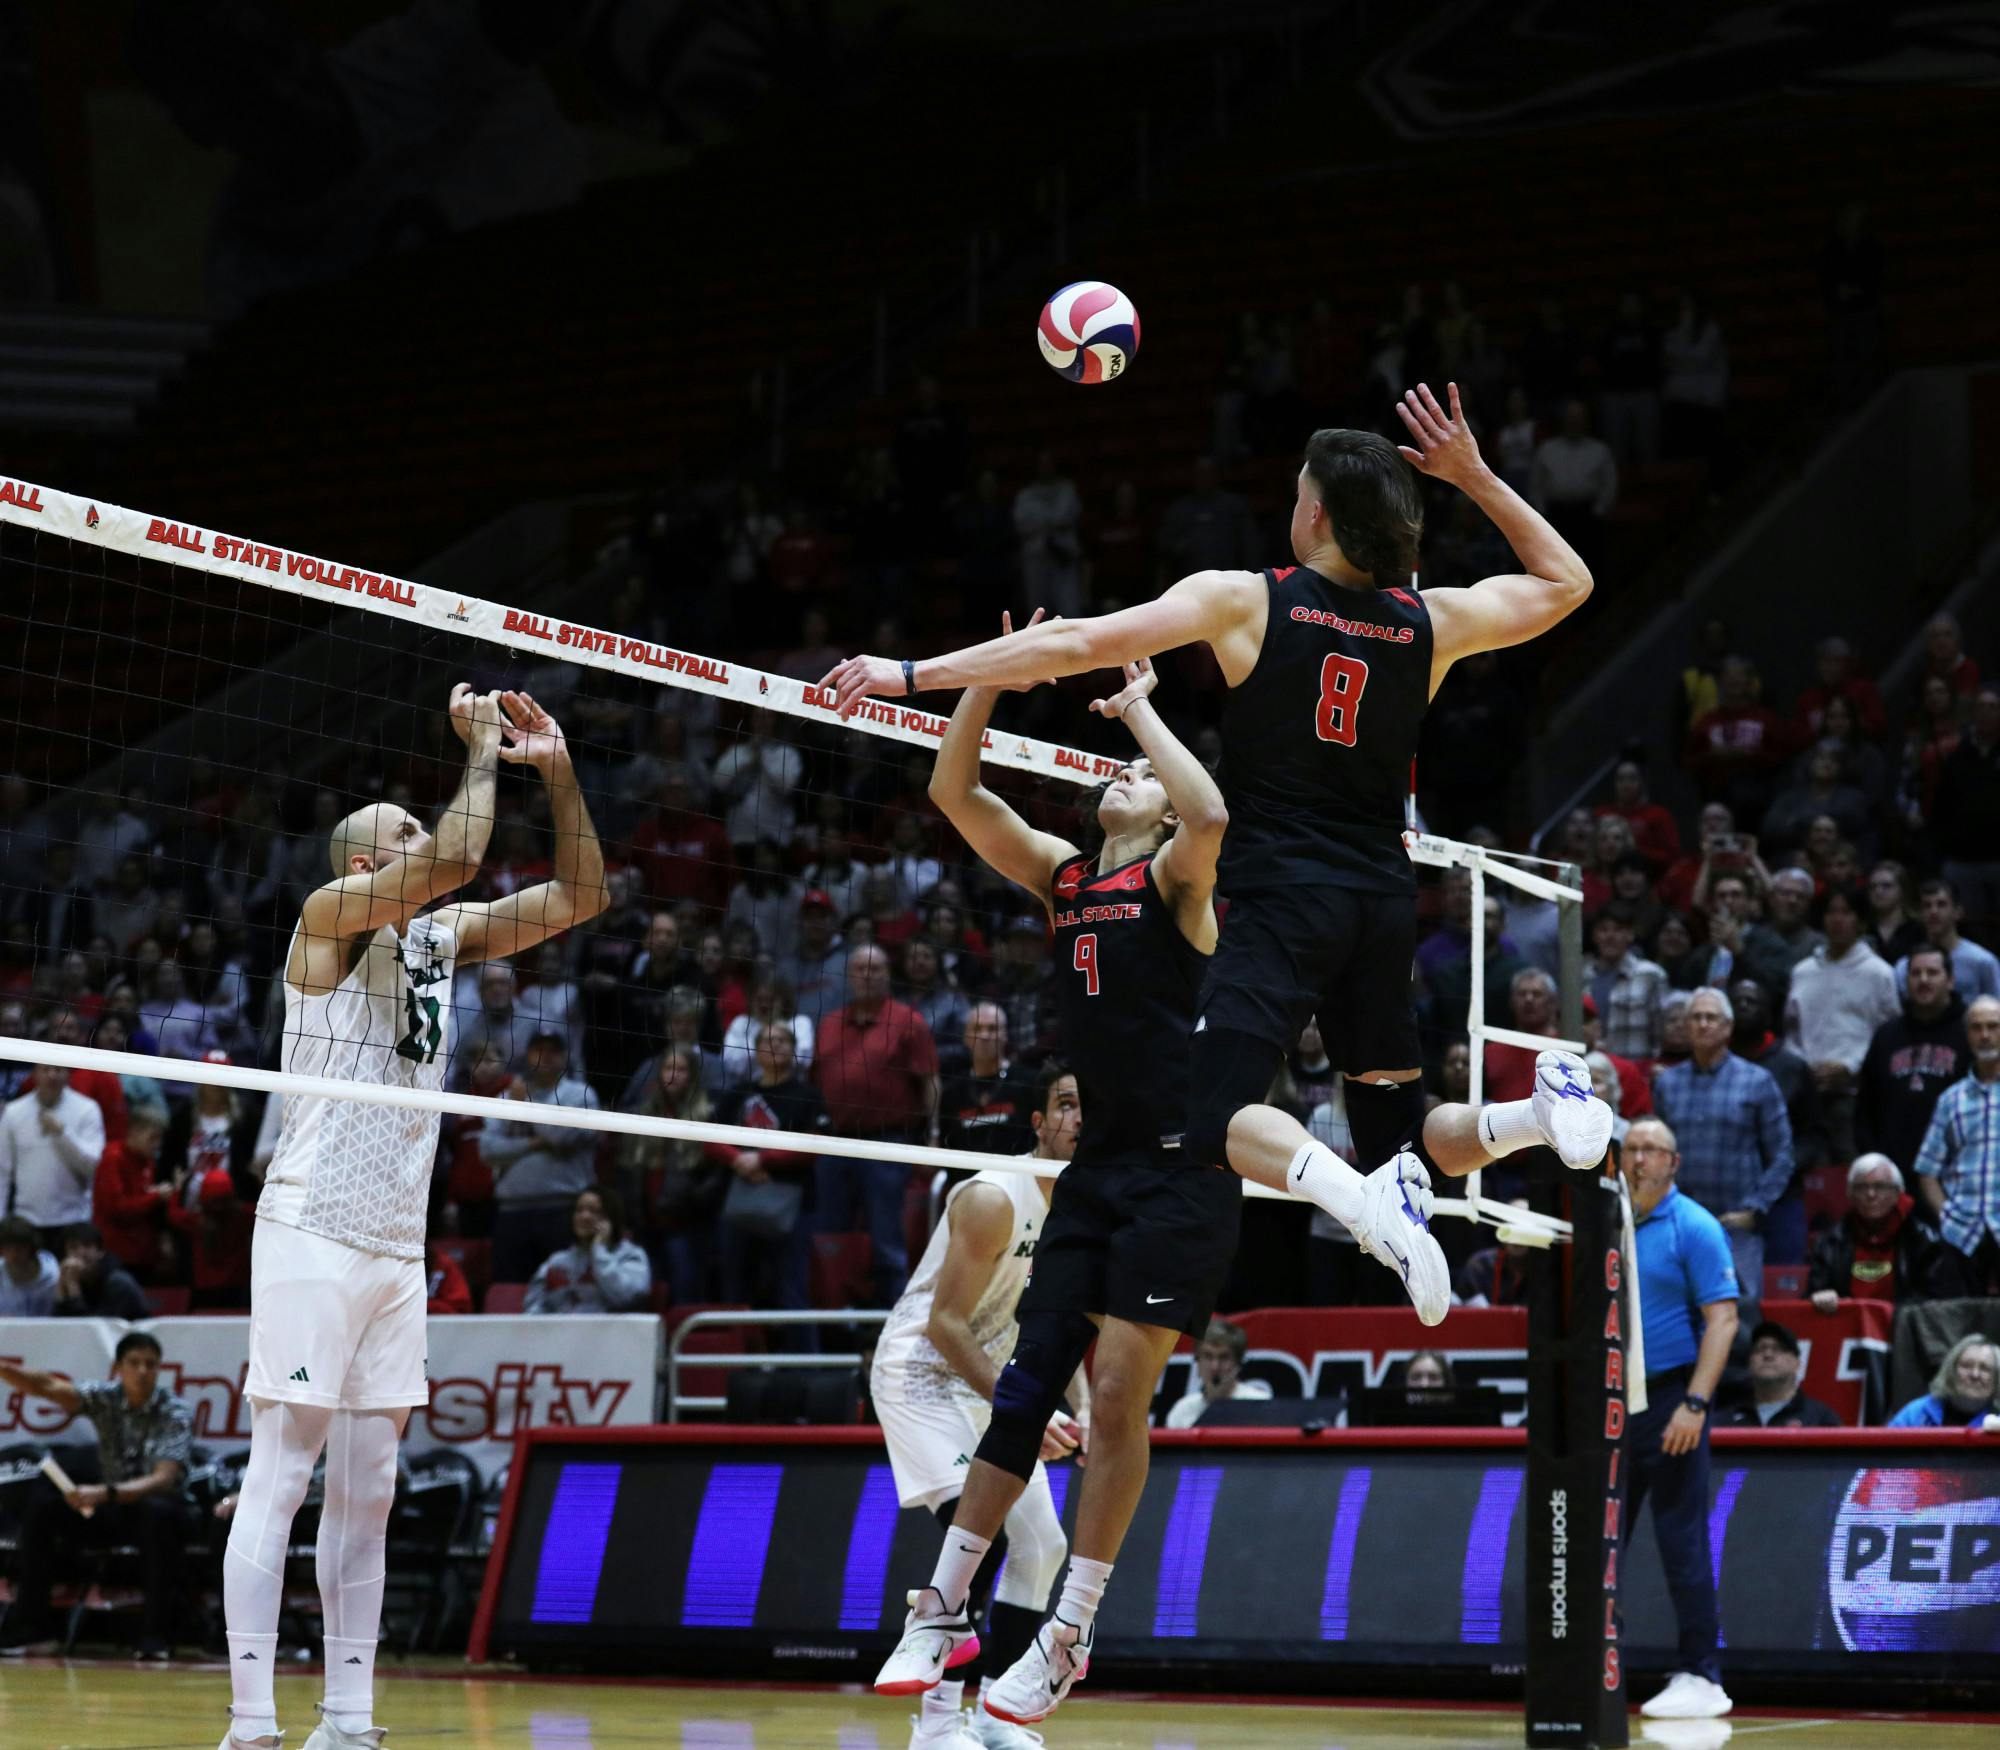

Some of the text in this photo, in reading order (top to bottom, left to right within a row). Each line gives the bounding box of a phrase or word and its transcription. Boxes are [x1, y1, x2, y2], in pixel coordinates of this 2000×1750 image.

[146, 519, 417, 608] BALL STATE VOLLEYBALL
[503, 610, 728, 685] BALL STATE VOLLEYBALL
[1290, 606, 1415, 644] CARDINALS
[1315, 652, 1369, 748] 8
[1055, 748, 1089, 772] BALL
[1082, 903, 1142, 923] STATE
[1073, 932, 1100, 997] 9
[1603, 1248, 1626, 1691] CARDINALS
[1549, 1488, 1568, 1640] sports imports
[1844, 1525, 2000, 1582] PEP
